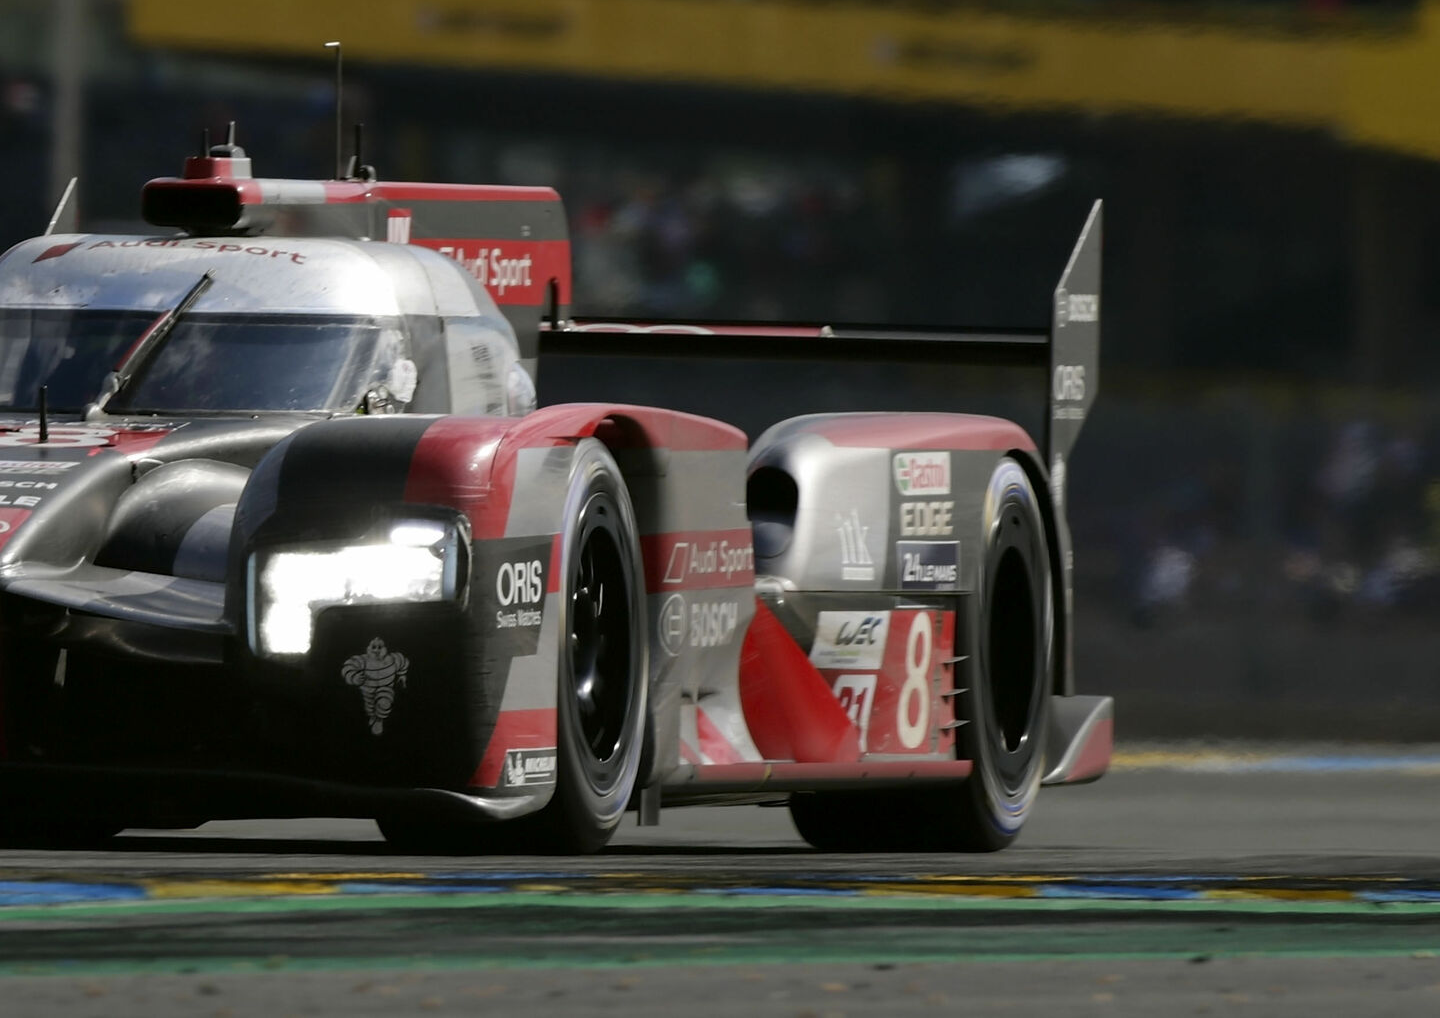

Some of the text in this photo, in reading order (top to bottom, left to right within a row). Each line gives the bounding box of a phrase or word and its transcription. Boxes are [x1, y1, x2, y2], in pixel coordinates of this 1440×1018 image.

[88, 239, 308, 265] Audi Sport
[456, 248, 532, 296] Audi Sport
[901, 501, 954, 536] EDGE
[496, 560, 542, 606] ORIS
[689, 541, 753, 580] Audi Sport
[690, 602, 738, 647] BOSCH
[897, 611, 932, 750] 8
